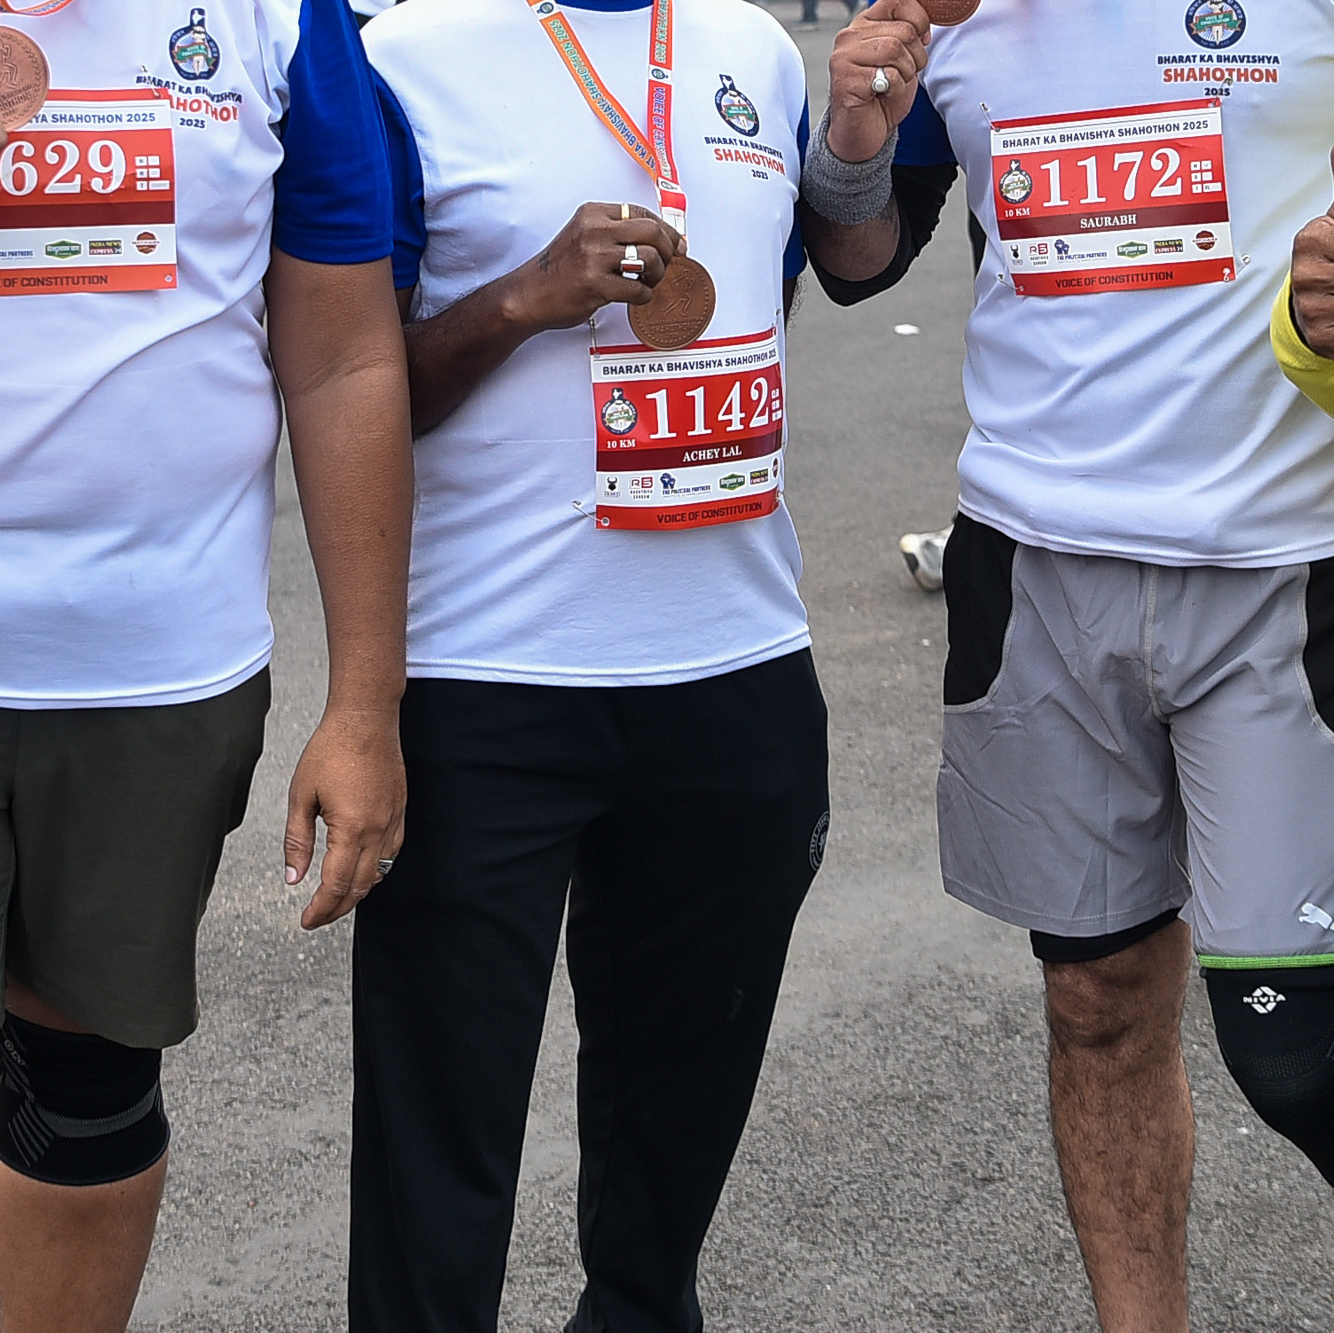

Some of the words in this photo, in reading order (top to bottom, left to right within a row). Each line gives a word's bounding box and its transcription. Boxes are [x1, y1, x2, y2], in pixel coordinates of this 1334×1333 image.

[547, 18, 569, 42] 2025
[1157, 55, 1197, 65] BHARAT
[1199, 54, 1214, 64] KA
[1216, 54, 1280, 65] BHAVISHYA
[562, 40, 603, 101] SHAHOTHON
[1163, 67, 1278, 83] SHAHOTHON
[136, 76, 177, 90] BHARAT
[178, 85, 192, 95] KA
[1204, 87, 1231, 97] 2025
[653, 86, 665, 114] VOICE
[51, 113, 122, 124] SHAHOTHON
[126, 113, 155, 123] 2025
[179, 118, 205, 129] 2025
[653, 115, 665, 132] OF
[704, 136, 738, 146] BHARAT
[739, 139, 750, 148] KA
[1002, 136, 1041, 149] BHARAT
[1043, 135, 1057, 145] KA
[1059, 129, 1116, 143] BHAVISHYA
[1117, 123, 1180, 138] SHAHOTHON
[1182, 120, 1209, 131] 2025
[633, 140, 649, 159] KA
[714, 148, 785, 176] SHAHOTHON
[1040, 147, 1182, 208] 1172
[1004, 209, 1014, 218] 10
[1015, 207, 1031, 216] KM
[1080, 214, 1137, 230] SAURABH
[3, 277, 17, 288] OF
[20, 274, 108, 287] CONSTITUTION
[1055, 278, 1082, 289] VOICE
[1084, 277, 1097, 287] OF
[1098, 271, 1174, 285] CONSTITUTION
[602, 364, 646, 375] BHARAT
[649, 363, 664, 373] KA
[666, 358, 723, 372] BHAVISHYA
[724, 352, 768, 366] SHAHOTHON
[645, 377, 769, 439] 1142
[606, 441, 618, 449] 10
[619, 439, 636, 448] KM
[682, 448, 720, 463] ACHEY
[722, 445, 742, 458] LAL
[657, 512, 687, 524] VOICE
[688, 511, 700, 521] OF
[701, 501, 763, 519] CONSTITUTION
[1242, 993, 1287, 1004] NIVIA
